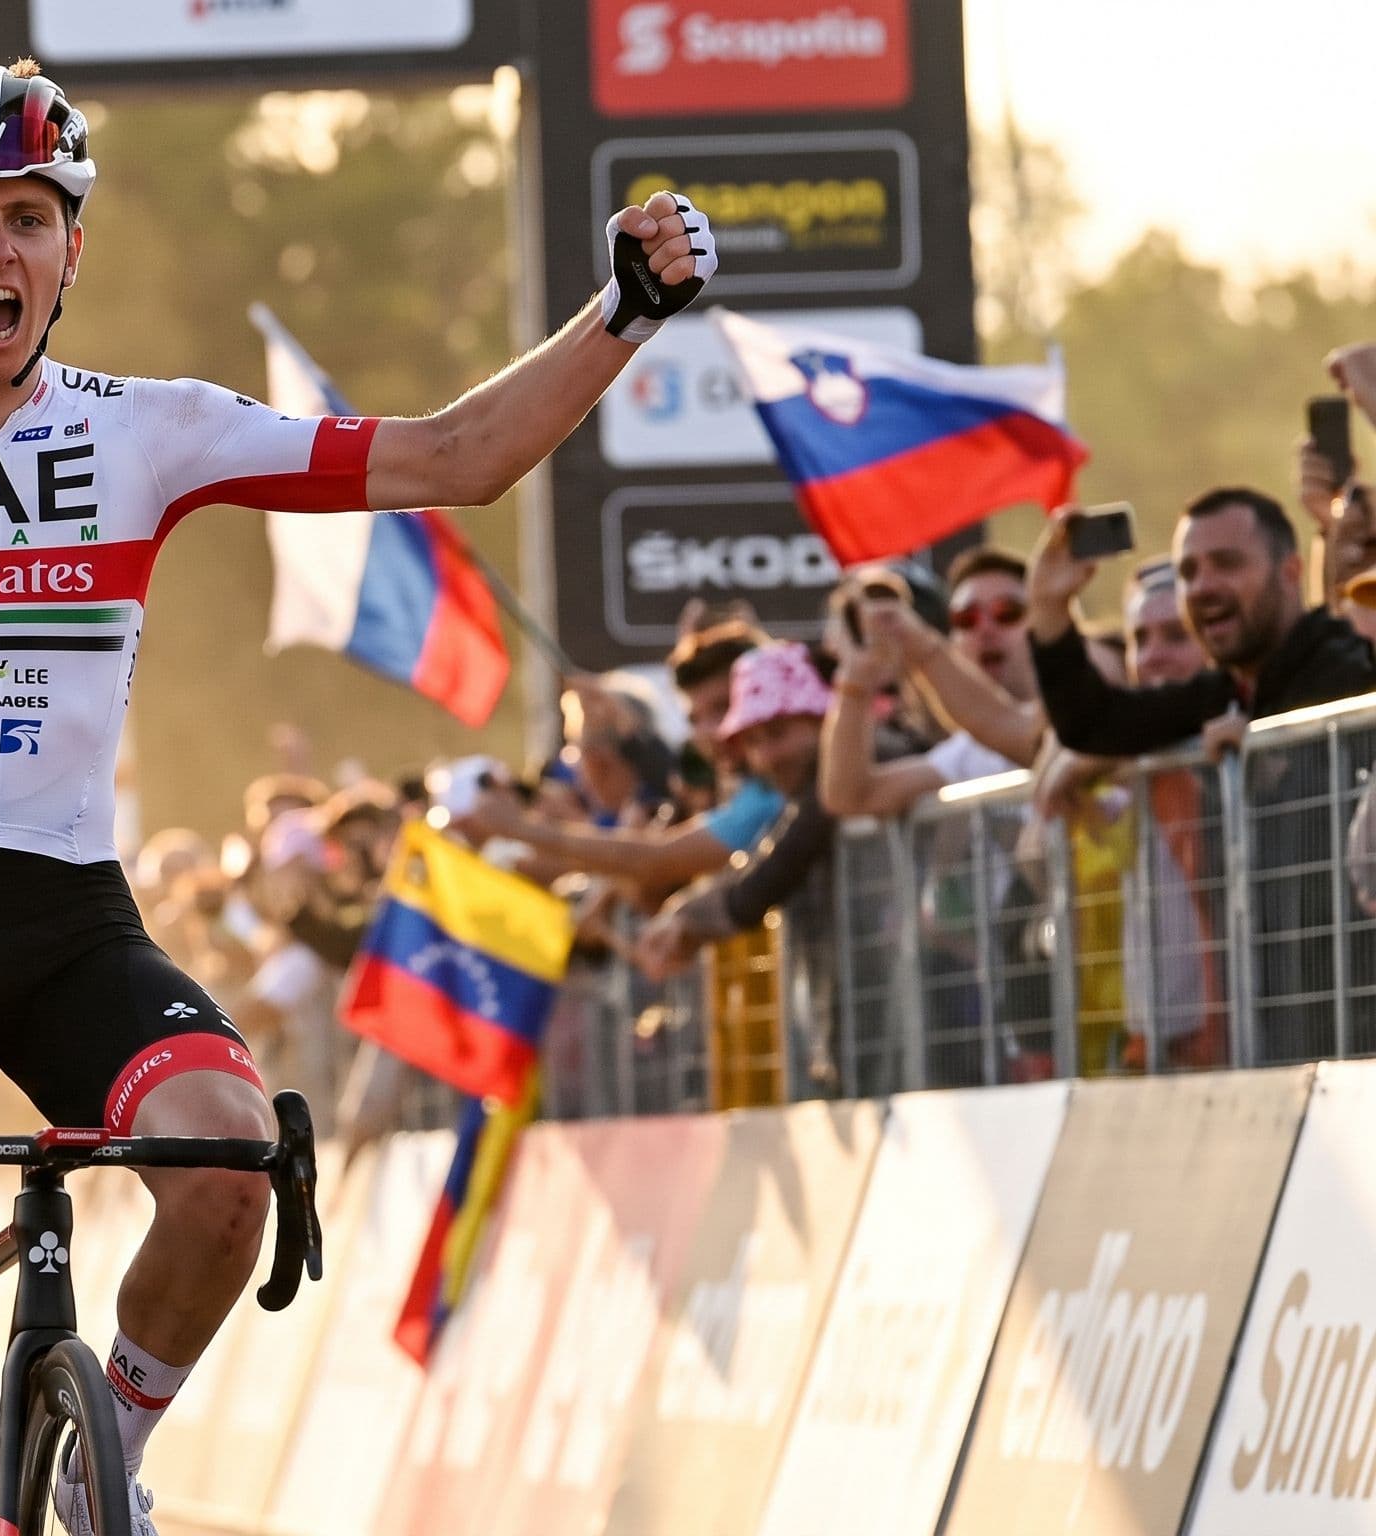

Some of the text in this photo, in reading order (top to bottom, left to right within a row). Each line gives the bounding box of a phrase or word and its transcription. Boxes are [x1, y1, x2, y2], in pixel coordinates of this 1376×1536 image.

[62, 368, 125, 398] UAE
[628, 528, 840, 593] ŠKOD
[14, 669, 48, 684] LEE
[111, 1049, 173, 1128] Emirates
[111, 1336, 147, 1388] UAE
